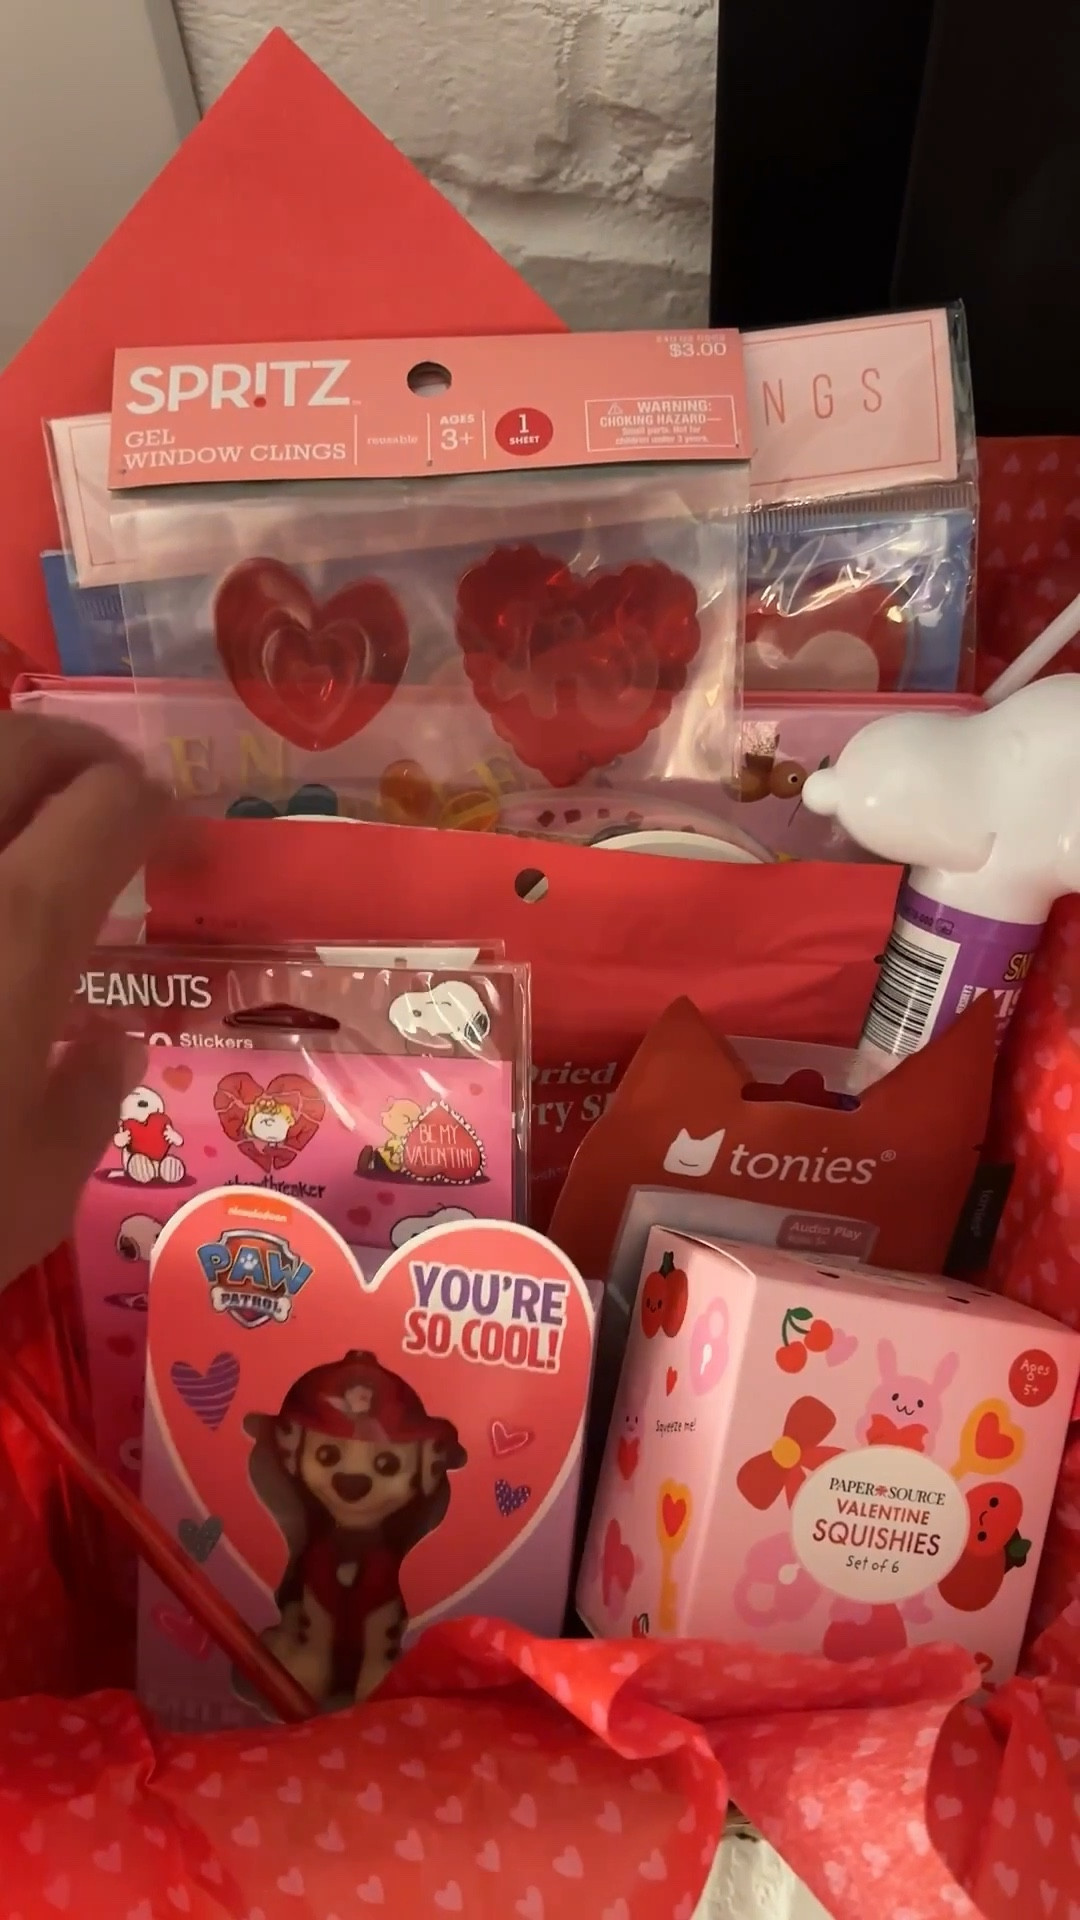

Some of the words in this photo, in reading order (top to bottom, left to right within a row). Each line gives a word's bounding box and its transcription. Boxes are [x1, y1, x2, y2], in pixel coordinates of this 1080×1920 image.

[669, 342, 727, 358] $3.00
[637, 399, 713, 414] WARNING:
[440, 414, 475, 425] AGES
[518, 413, 530, 434] 1
[600, 414, 653, 428] CHOKING
[125, 429, 176, 449] GEL
[367, 434, 418, 445] reusable
[440, 428, 475, 451] 3+
[508, 435, 541, 446] SHEET
[124, 447, 244, 470] WINDOW
[250, 443, 346, 463] CLINGS
[179, 1032, 253, 1049] Stickers
[419, 1123, 438, 1144] BE
[439, 1123, 460, 1145] MY
[789, 1221, 831, 1236] Audio
[833, 1226, 862, 1241] Play
[197, 1243, 315, 1296] PAW
[221, 1292, 283, 1315] PATROL
[411, 1263, 568, 1328] YOU'RE
[405, 1310, 452, 1355] SO
[460, 1318, 560, 1371] COOL!
[1020, 1359, 1050, 1381] Ages
[1023, 1383, 1040, 1396] 5+
[655, 1419, 682, 1438] Squeeze
[684, 1417, 697, 1432] me!
[829, 1476, 876, 1497] PAPER
[887, 1485, 947, 1506] SOURCE
[836, 1498, 932, 1526] VALENTINE
[812, 1517, 942, 1557] SQUISHIES
[846, 1554, 869, 1571] Set
[871, 1558, 889, 1573] of
[891, 1560, 901, 1574] 6
